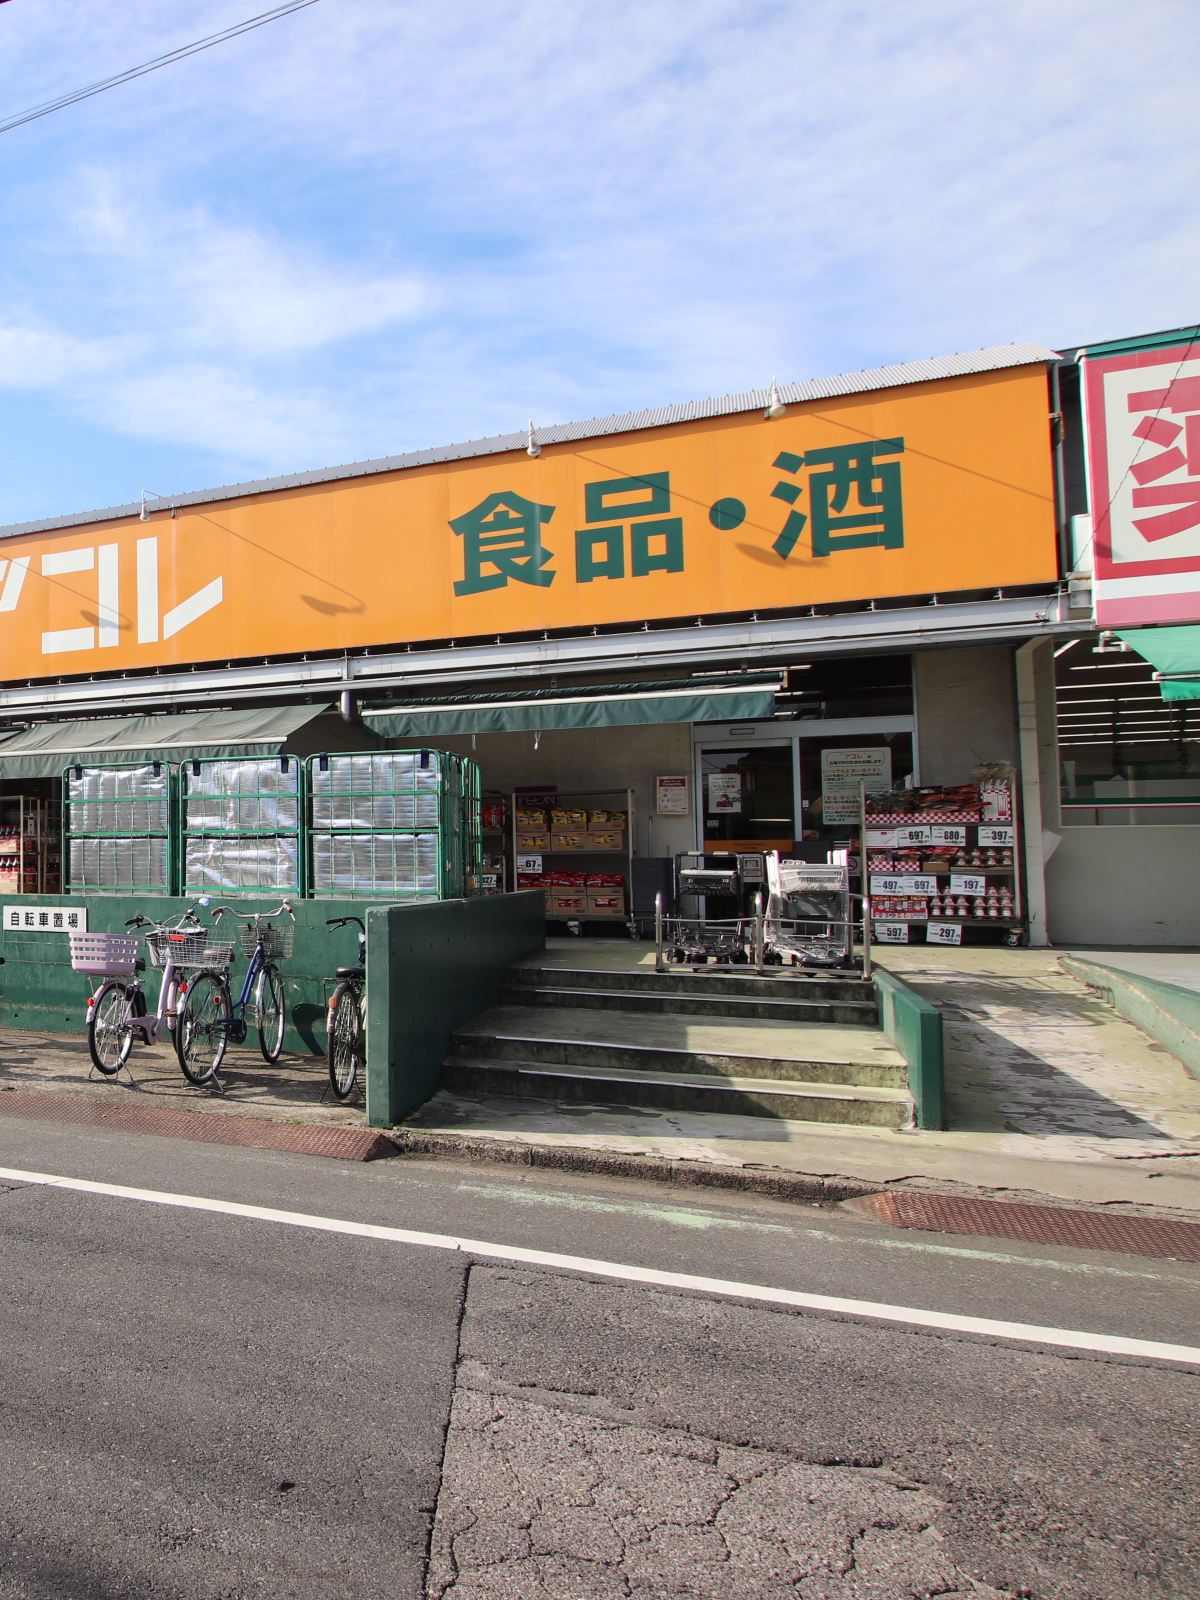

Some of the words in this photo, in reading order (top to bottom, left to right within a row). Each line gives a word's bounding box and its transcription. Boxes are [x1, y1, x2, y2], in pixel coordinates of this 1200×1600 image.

[447, 436, 904, 597] 食品・酒
[11, 911, 78, 928] 自転車置場
